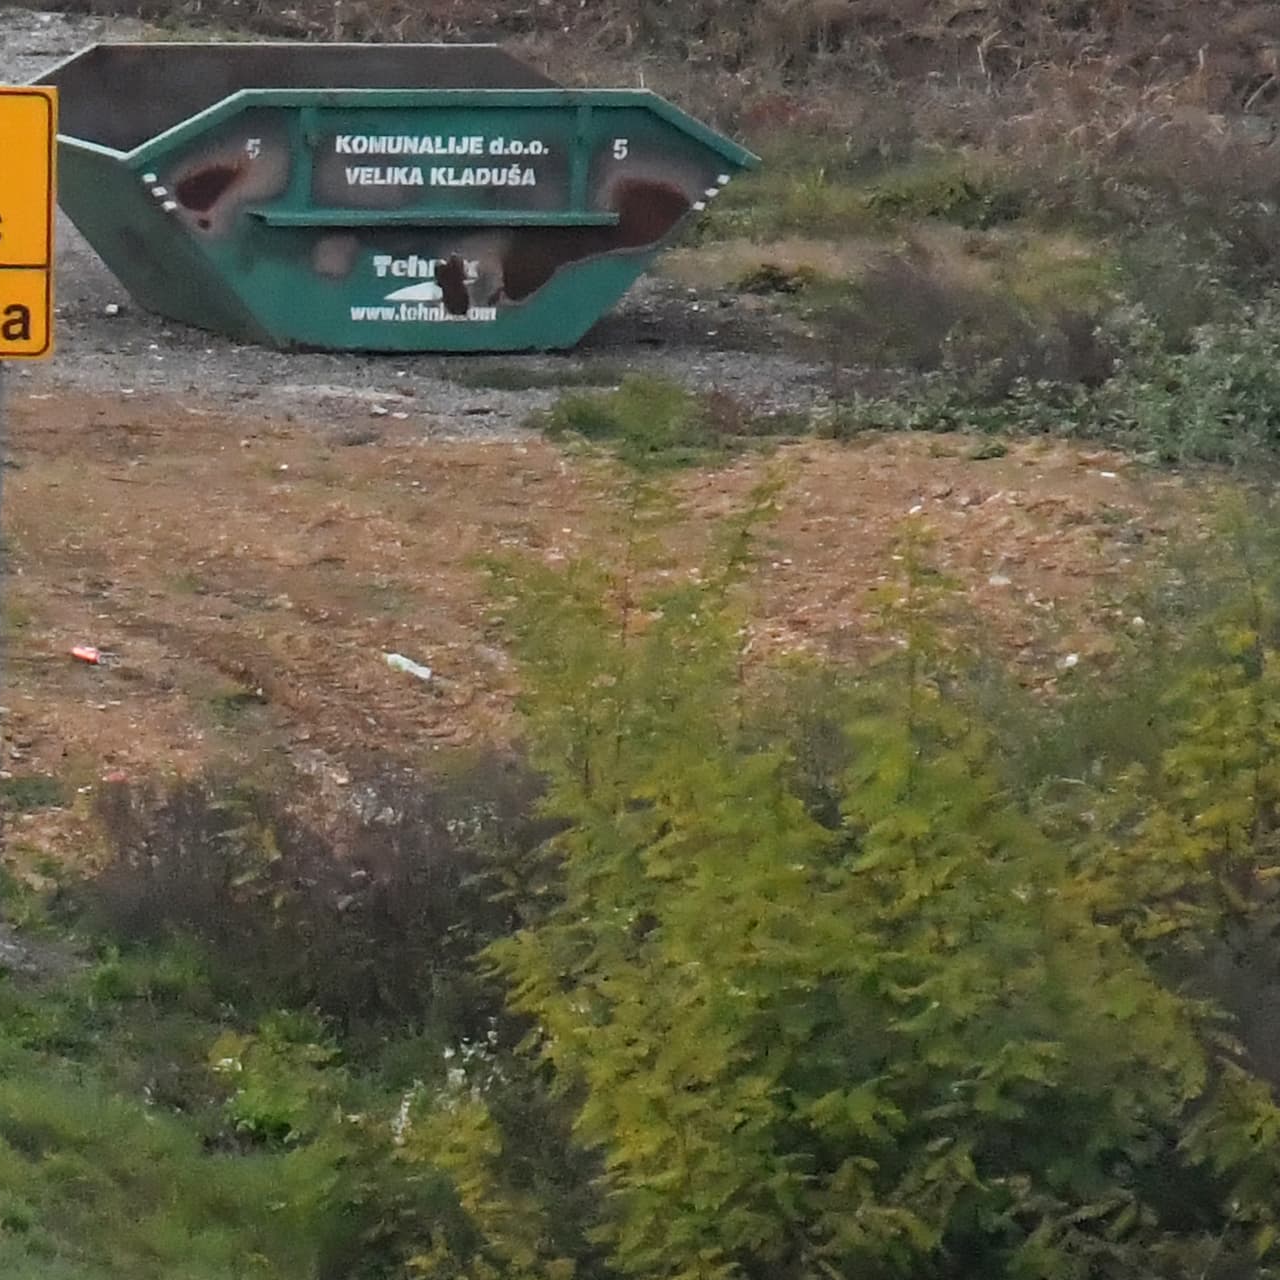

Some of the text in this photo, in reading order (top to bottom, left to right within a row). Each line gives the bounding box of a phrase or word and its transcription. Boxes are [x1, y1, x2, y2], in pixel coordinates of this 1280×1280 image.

[335, 135, 550, 156] KOMUNALIJE d.o.o.
[613, 138, 628, 160] 5
[344, 163, 537, 187] VELIKA KLADUŠA
[372, 254, 480, 279] Tehnx
